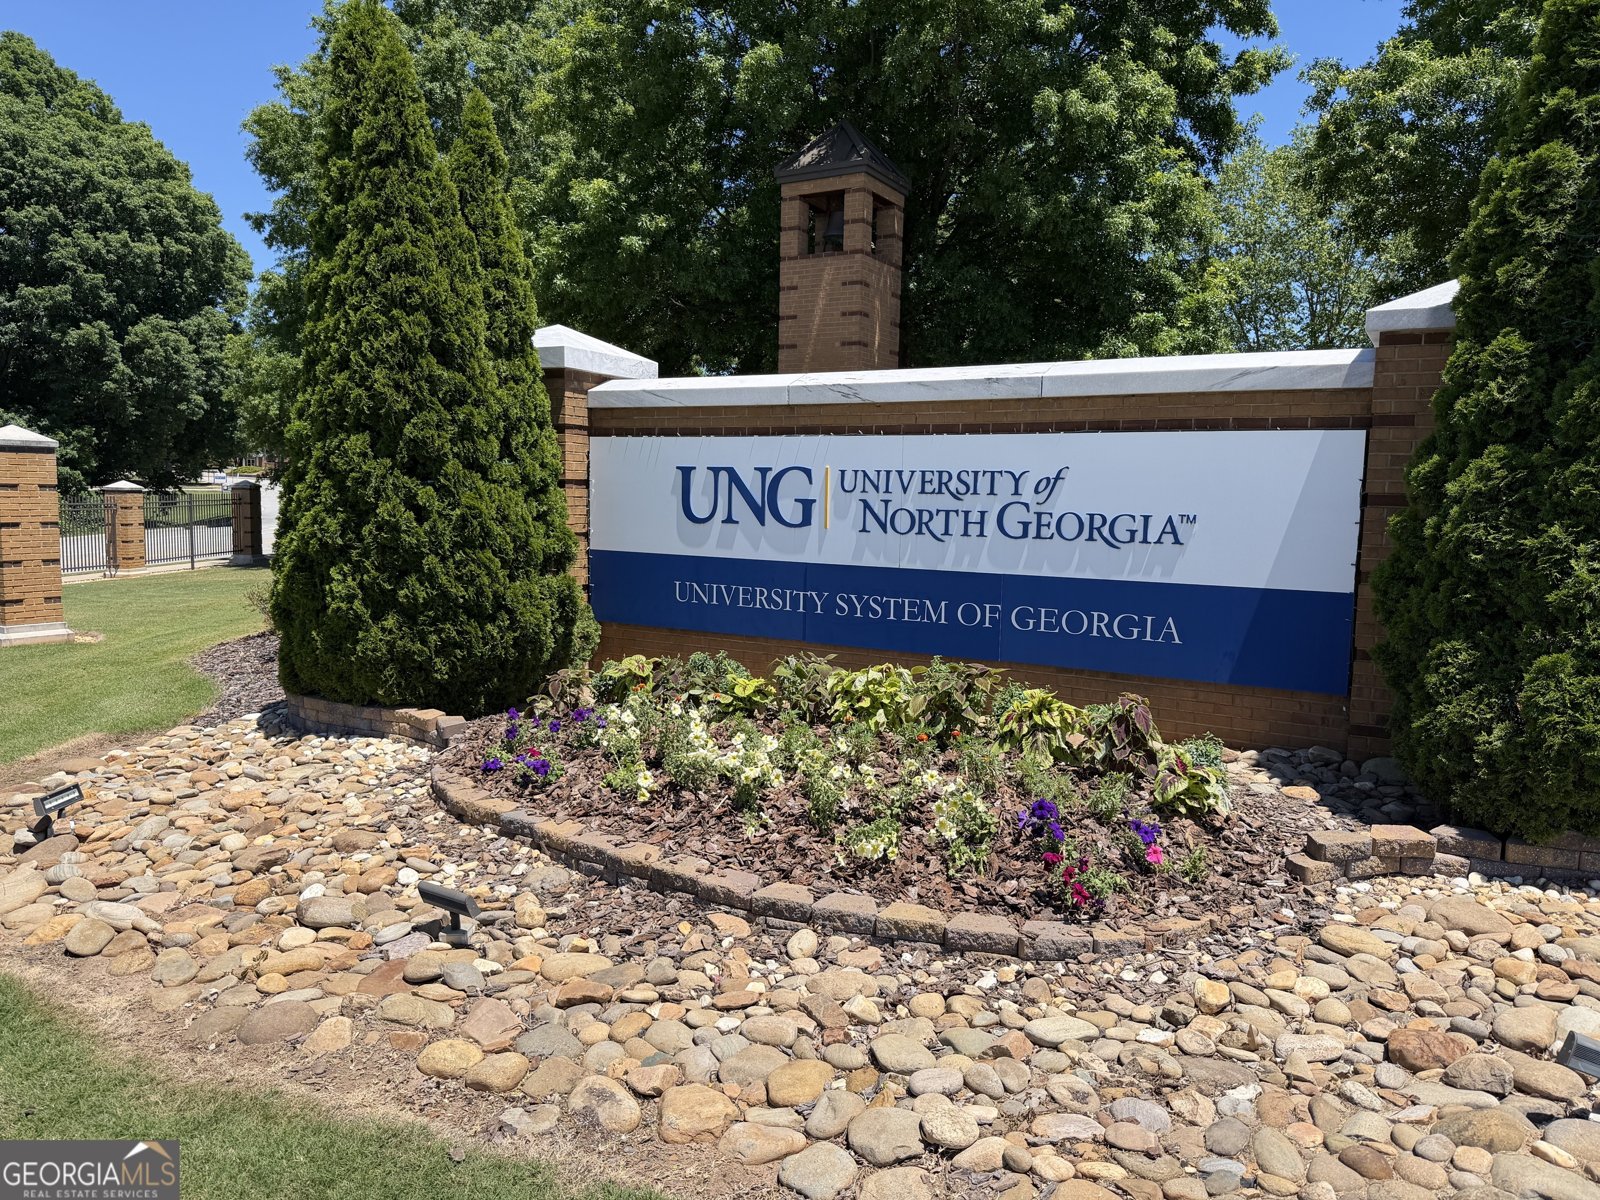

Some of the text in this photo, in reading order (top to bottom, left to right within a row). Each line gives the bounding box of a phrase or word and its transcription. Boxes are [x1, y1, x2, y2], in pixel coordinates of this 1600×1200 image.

[676, 465, 817, 529] UNG
[838, 466, 1070, 506] UNIVERSITY of
[858, 498, 989, 543] NORTH
[674, 580, 1183, 645] UNIVERSITY SYSTEM OF GEORGIA
